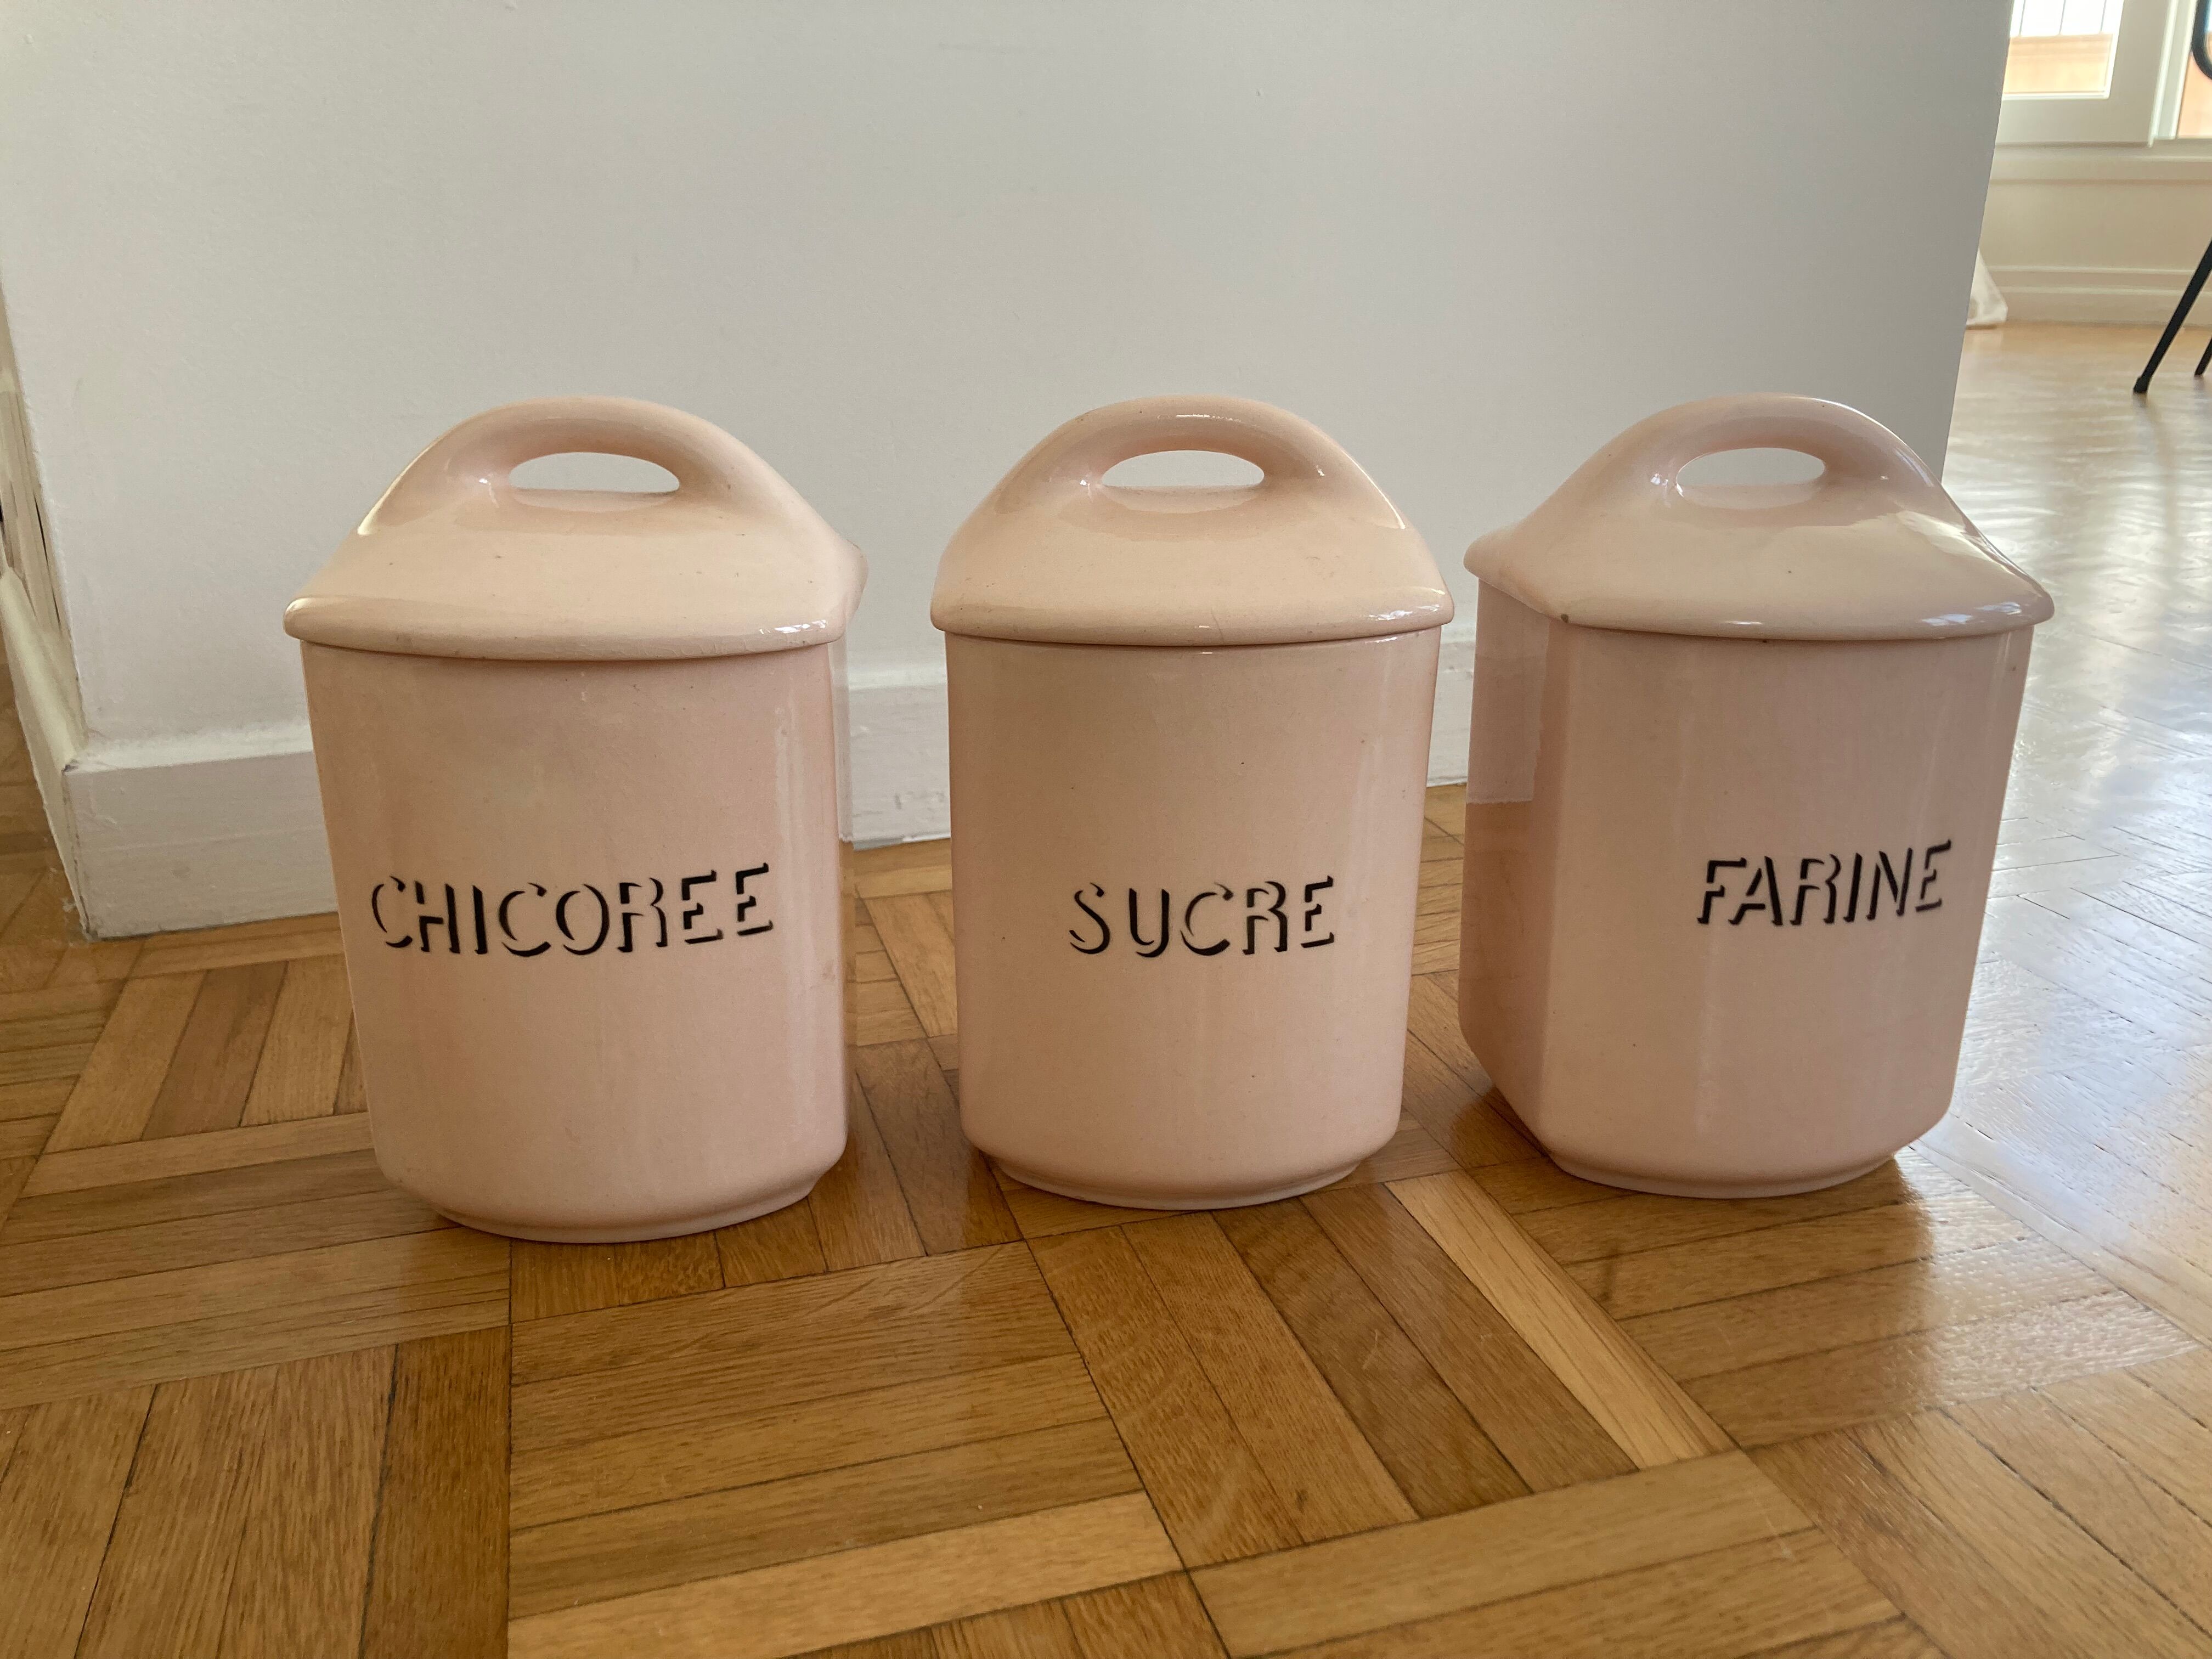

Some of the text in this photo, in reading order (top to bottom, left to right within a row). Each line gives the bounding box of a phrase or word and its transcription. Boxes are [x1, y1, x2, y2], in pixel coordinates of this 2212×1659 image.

[371, 862, 774, 958] CHICOREE
[1068, 874, 1335, 958] SUCRE
[1696, 839, 1952, 927] FARINE
